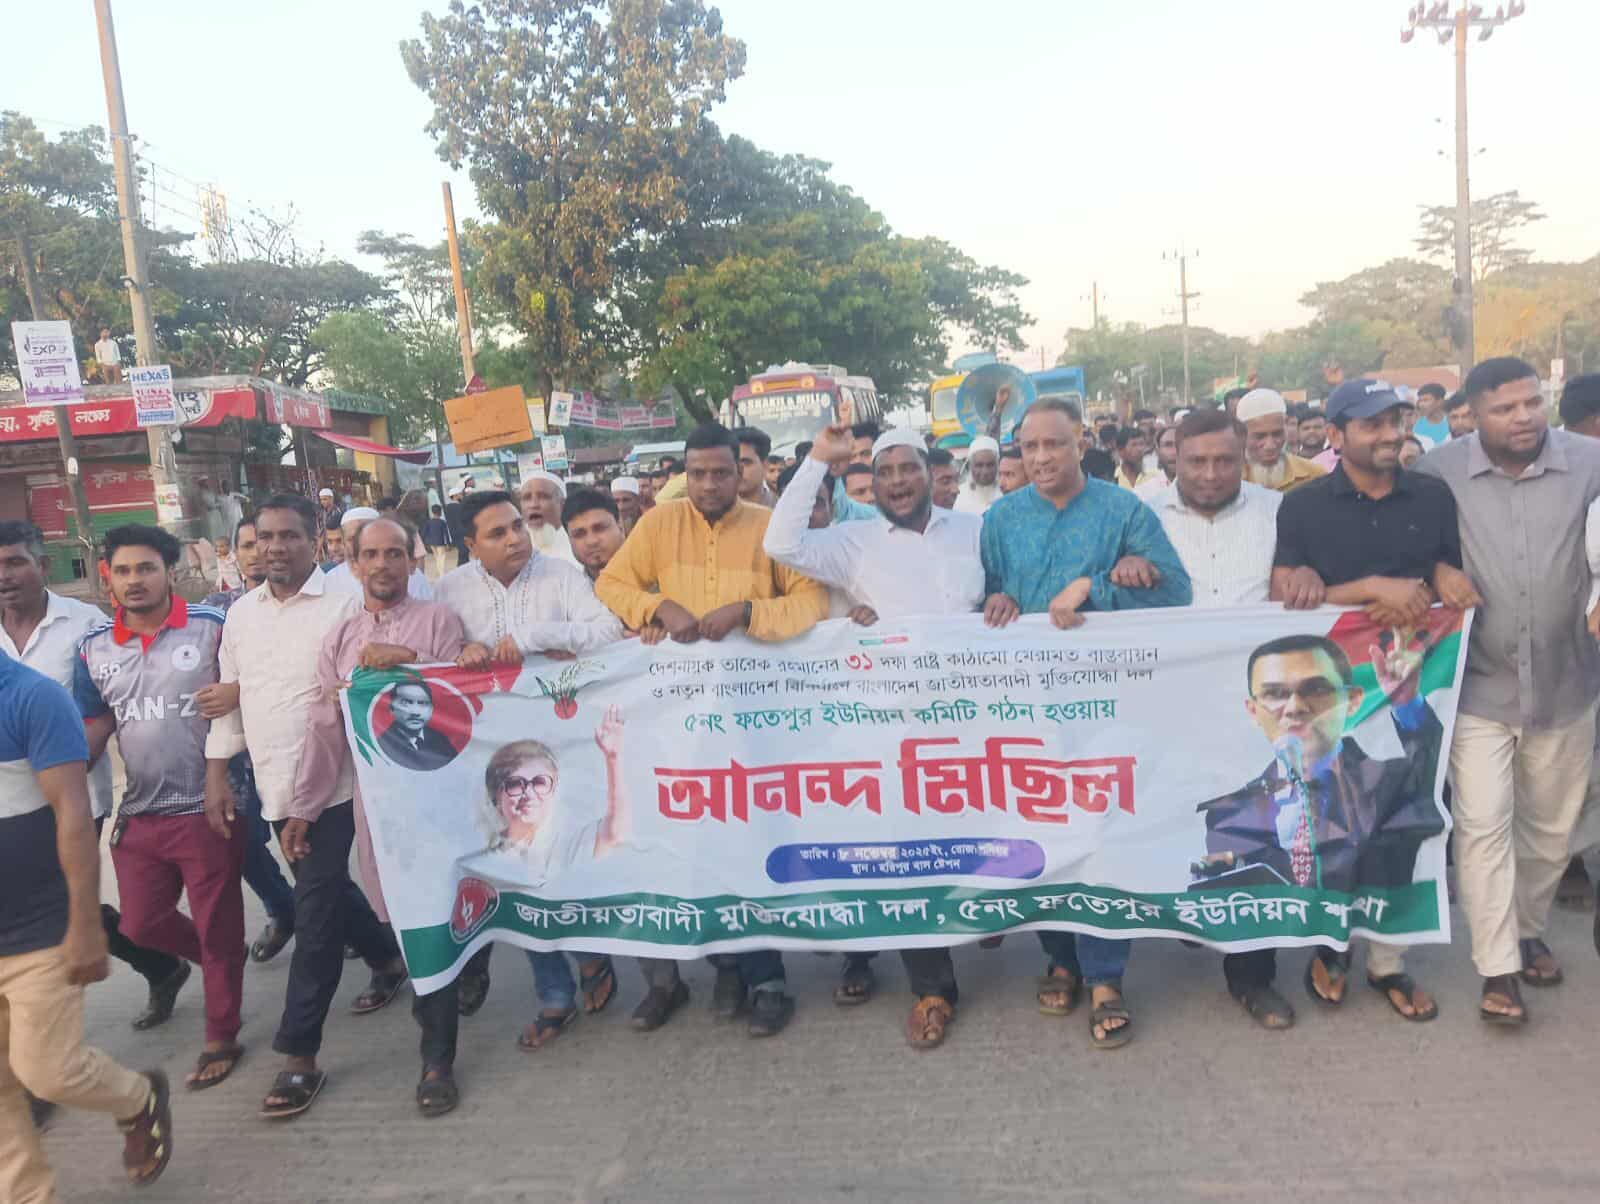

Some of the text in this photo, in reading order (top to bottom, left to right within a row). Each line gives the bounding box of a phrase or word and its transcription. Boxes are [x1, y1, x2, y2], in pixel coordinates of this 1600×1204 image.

[721, 655, 771, 674] তারেক
[845, 653, 873, 671] ৩১
[947, 648, 1007, 666] কাঠামো
[669, 681, 705, 699] নতুন
[711, 677, 778, 698] বাংলাদেশ
[684, 695, 1119, 734] ৫নং ফতেপুর ইউনিয়ন কমিটি গঠন হওয়ায়
[653, 736, 1137, 824] আনন্দ মিছিল
[514, 901, 706, 932] জাতীয়তাবাদী
[715, 899, 868, 931] মুক্তিযোদ্ধা
[958, 897, 1025, 921] ৫নং
[1032, 892, 1163, 922] ফতেপুর
[1173, 891, 1310, 929] ইউনিয়ন
[1319, 895, 1389, 928] শখা
